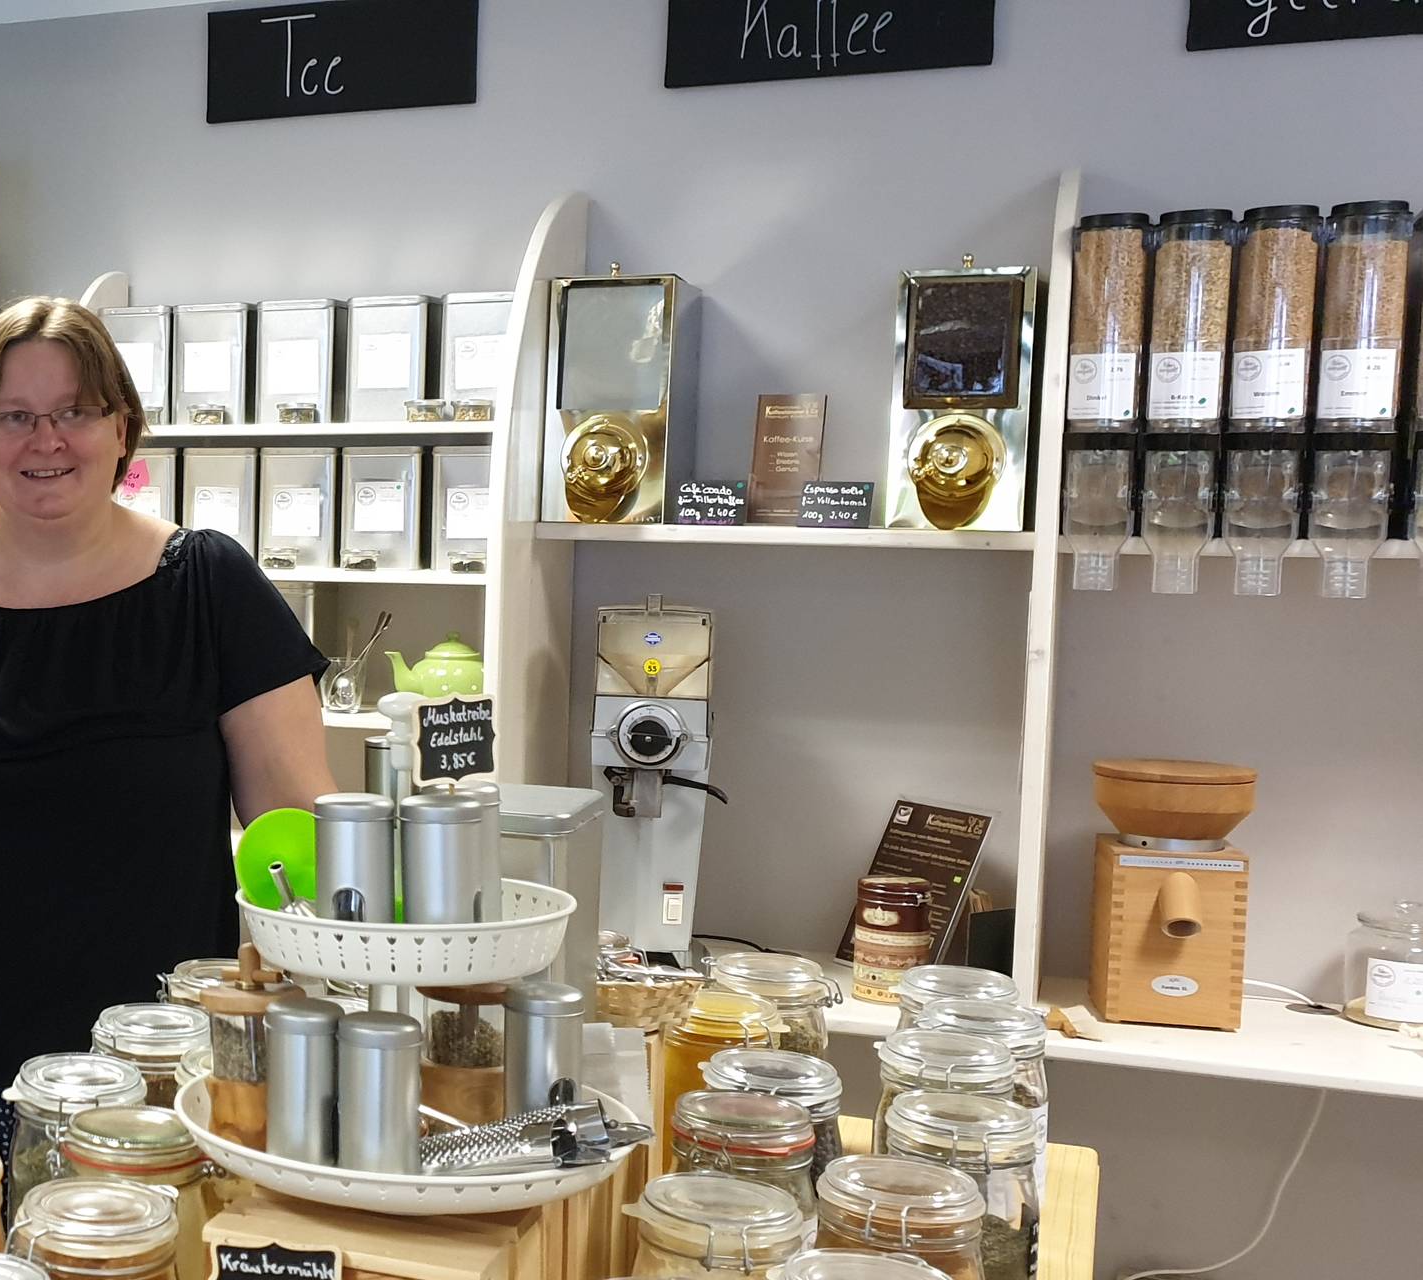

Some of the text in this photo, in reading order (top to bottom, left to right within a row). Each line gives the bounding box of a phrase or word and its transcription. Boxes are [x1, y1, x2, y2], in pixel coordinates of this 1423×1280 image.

[740, 0, 893, 70] Kaffee
[679, 507, 701, 521] 100g
[802, 510, 823, 523] 100g
[423, 702, 493, 727] Muskatreibe
[430, 726, 484, 748] Edelstahl
